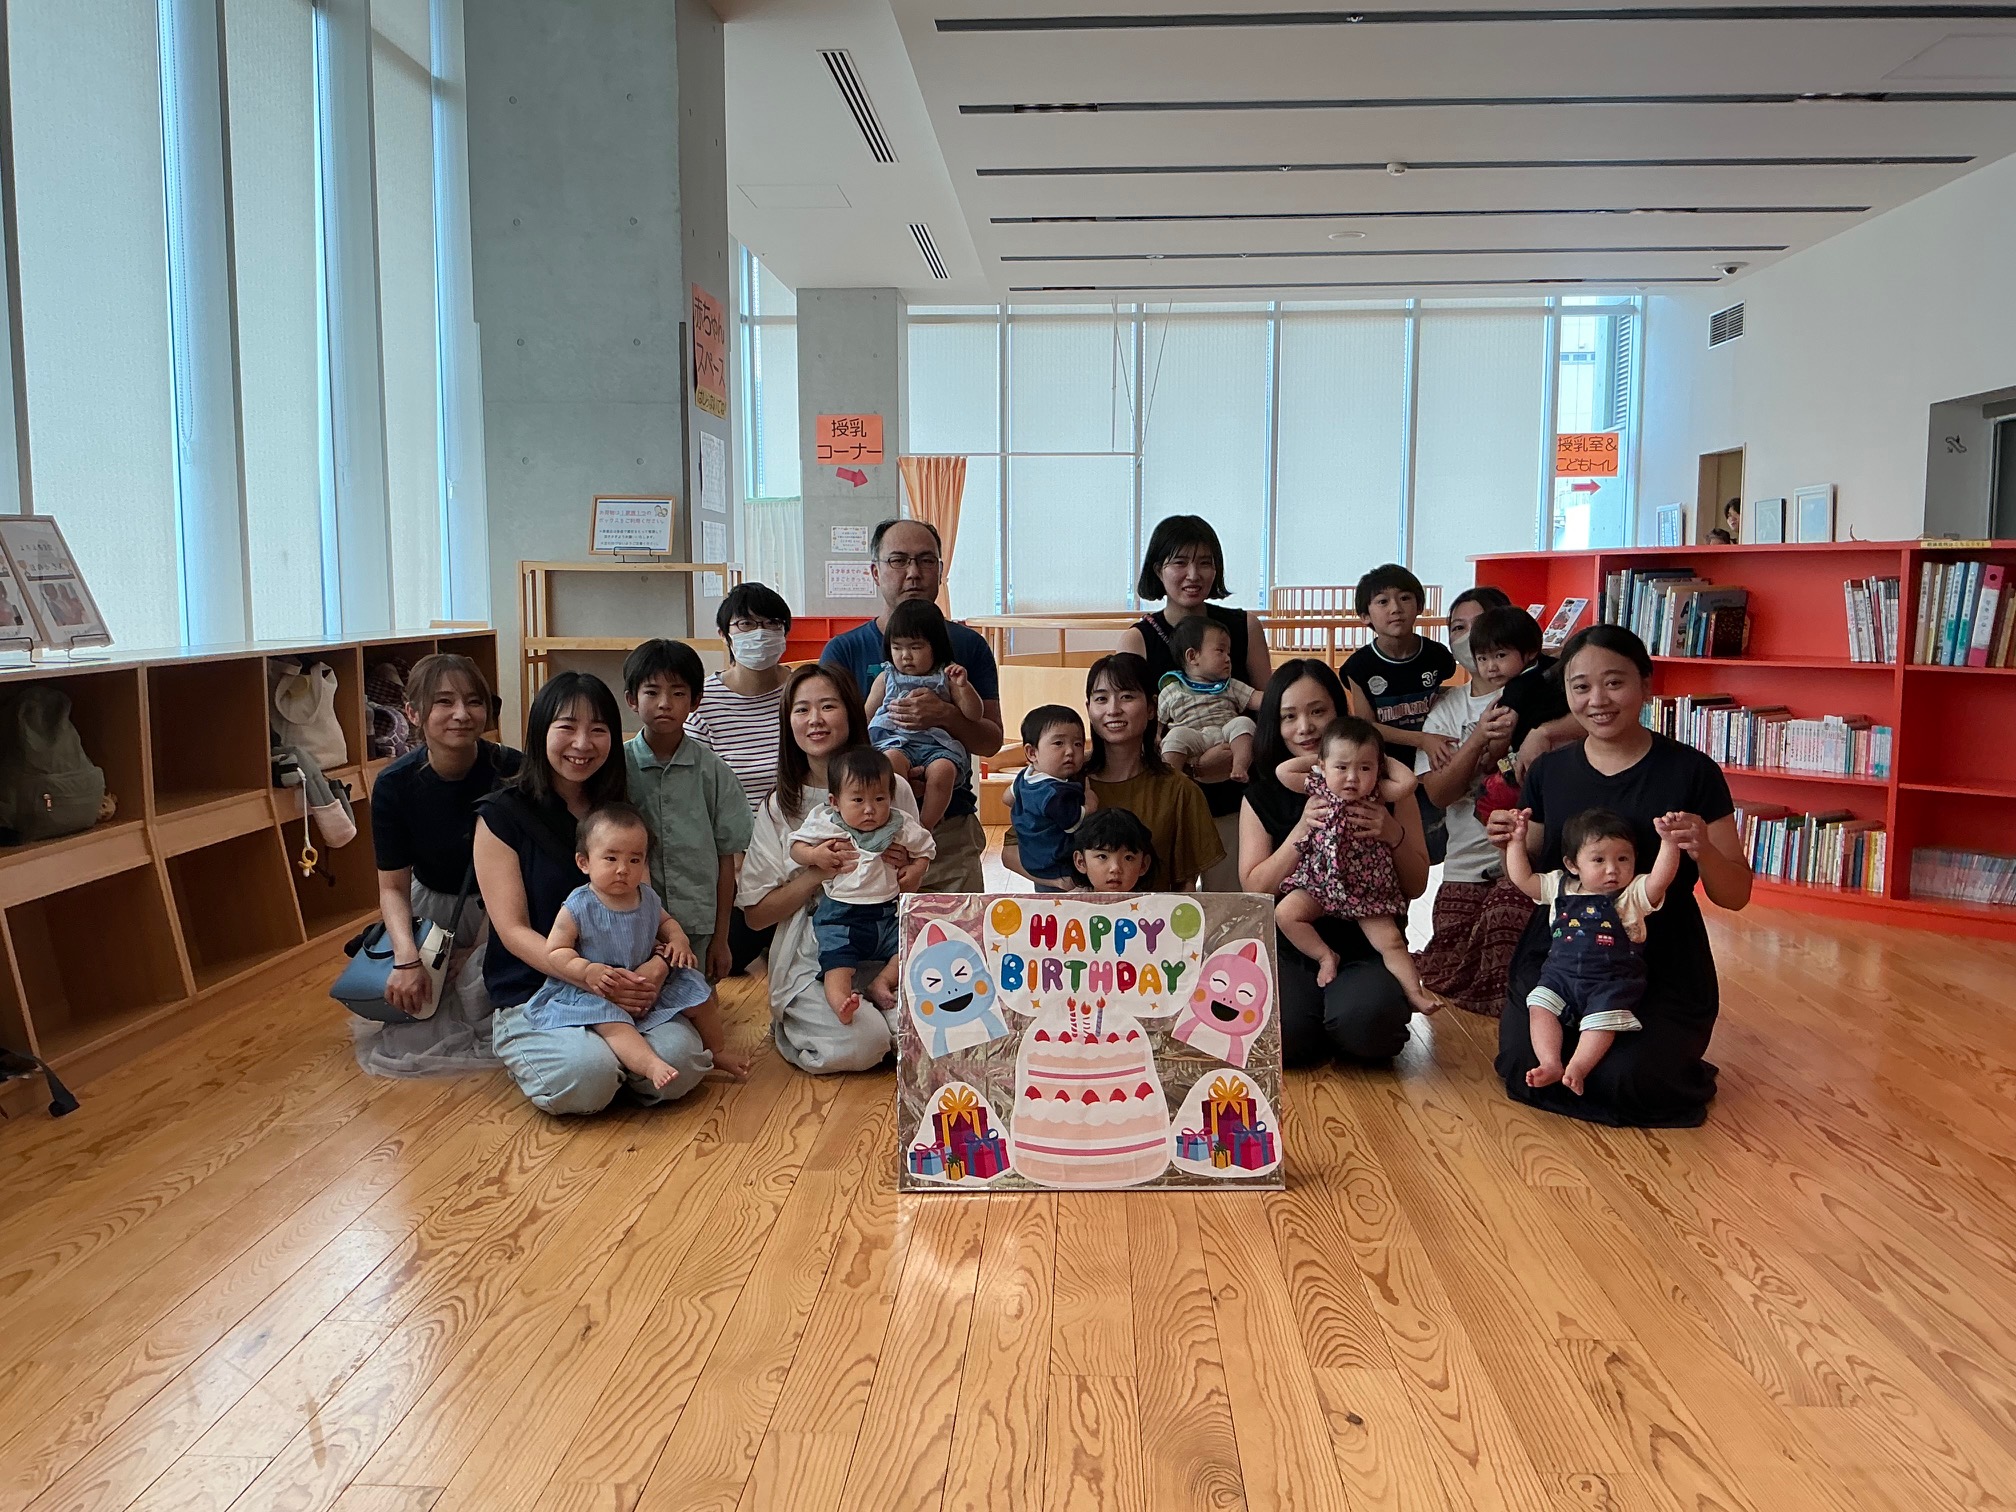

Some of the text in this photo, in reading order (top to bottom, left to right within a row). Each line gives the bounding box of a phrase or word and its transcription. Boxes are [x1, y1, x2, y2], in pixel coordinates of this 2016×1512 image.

[694, 295, 725, 344] 赤ちゃん
[696, 342, 726, 388] スペース
[831, 418, 867, 437] 授乳
[817, 442, 882, 460] コーナー
[1556, 458, 1618, 471] こどもトイレ
[1029, 913, 1165, 956] HAPPY
[1000, 953, 1186, 997] BIRTHDAY
